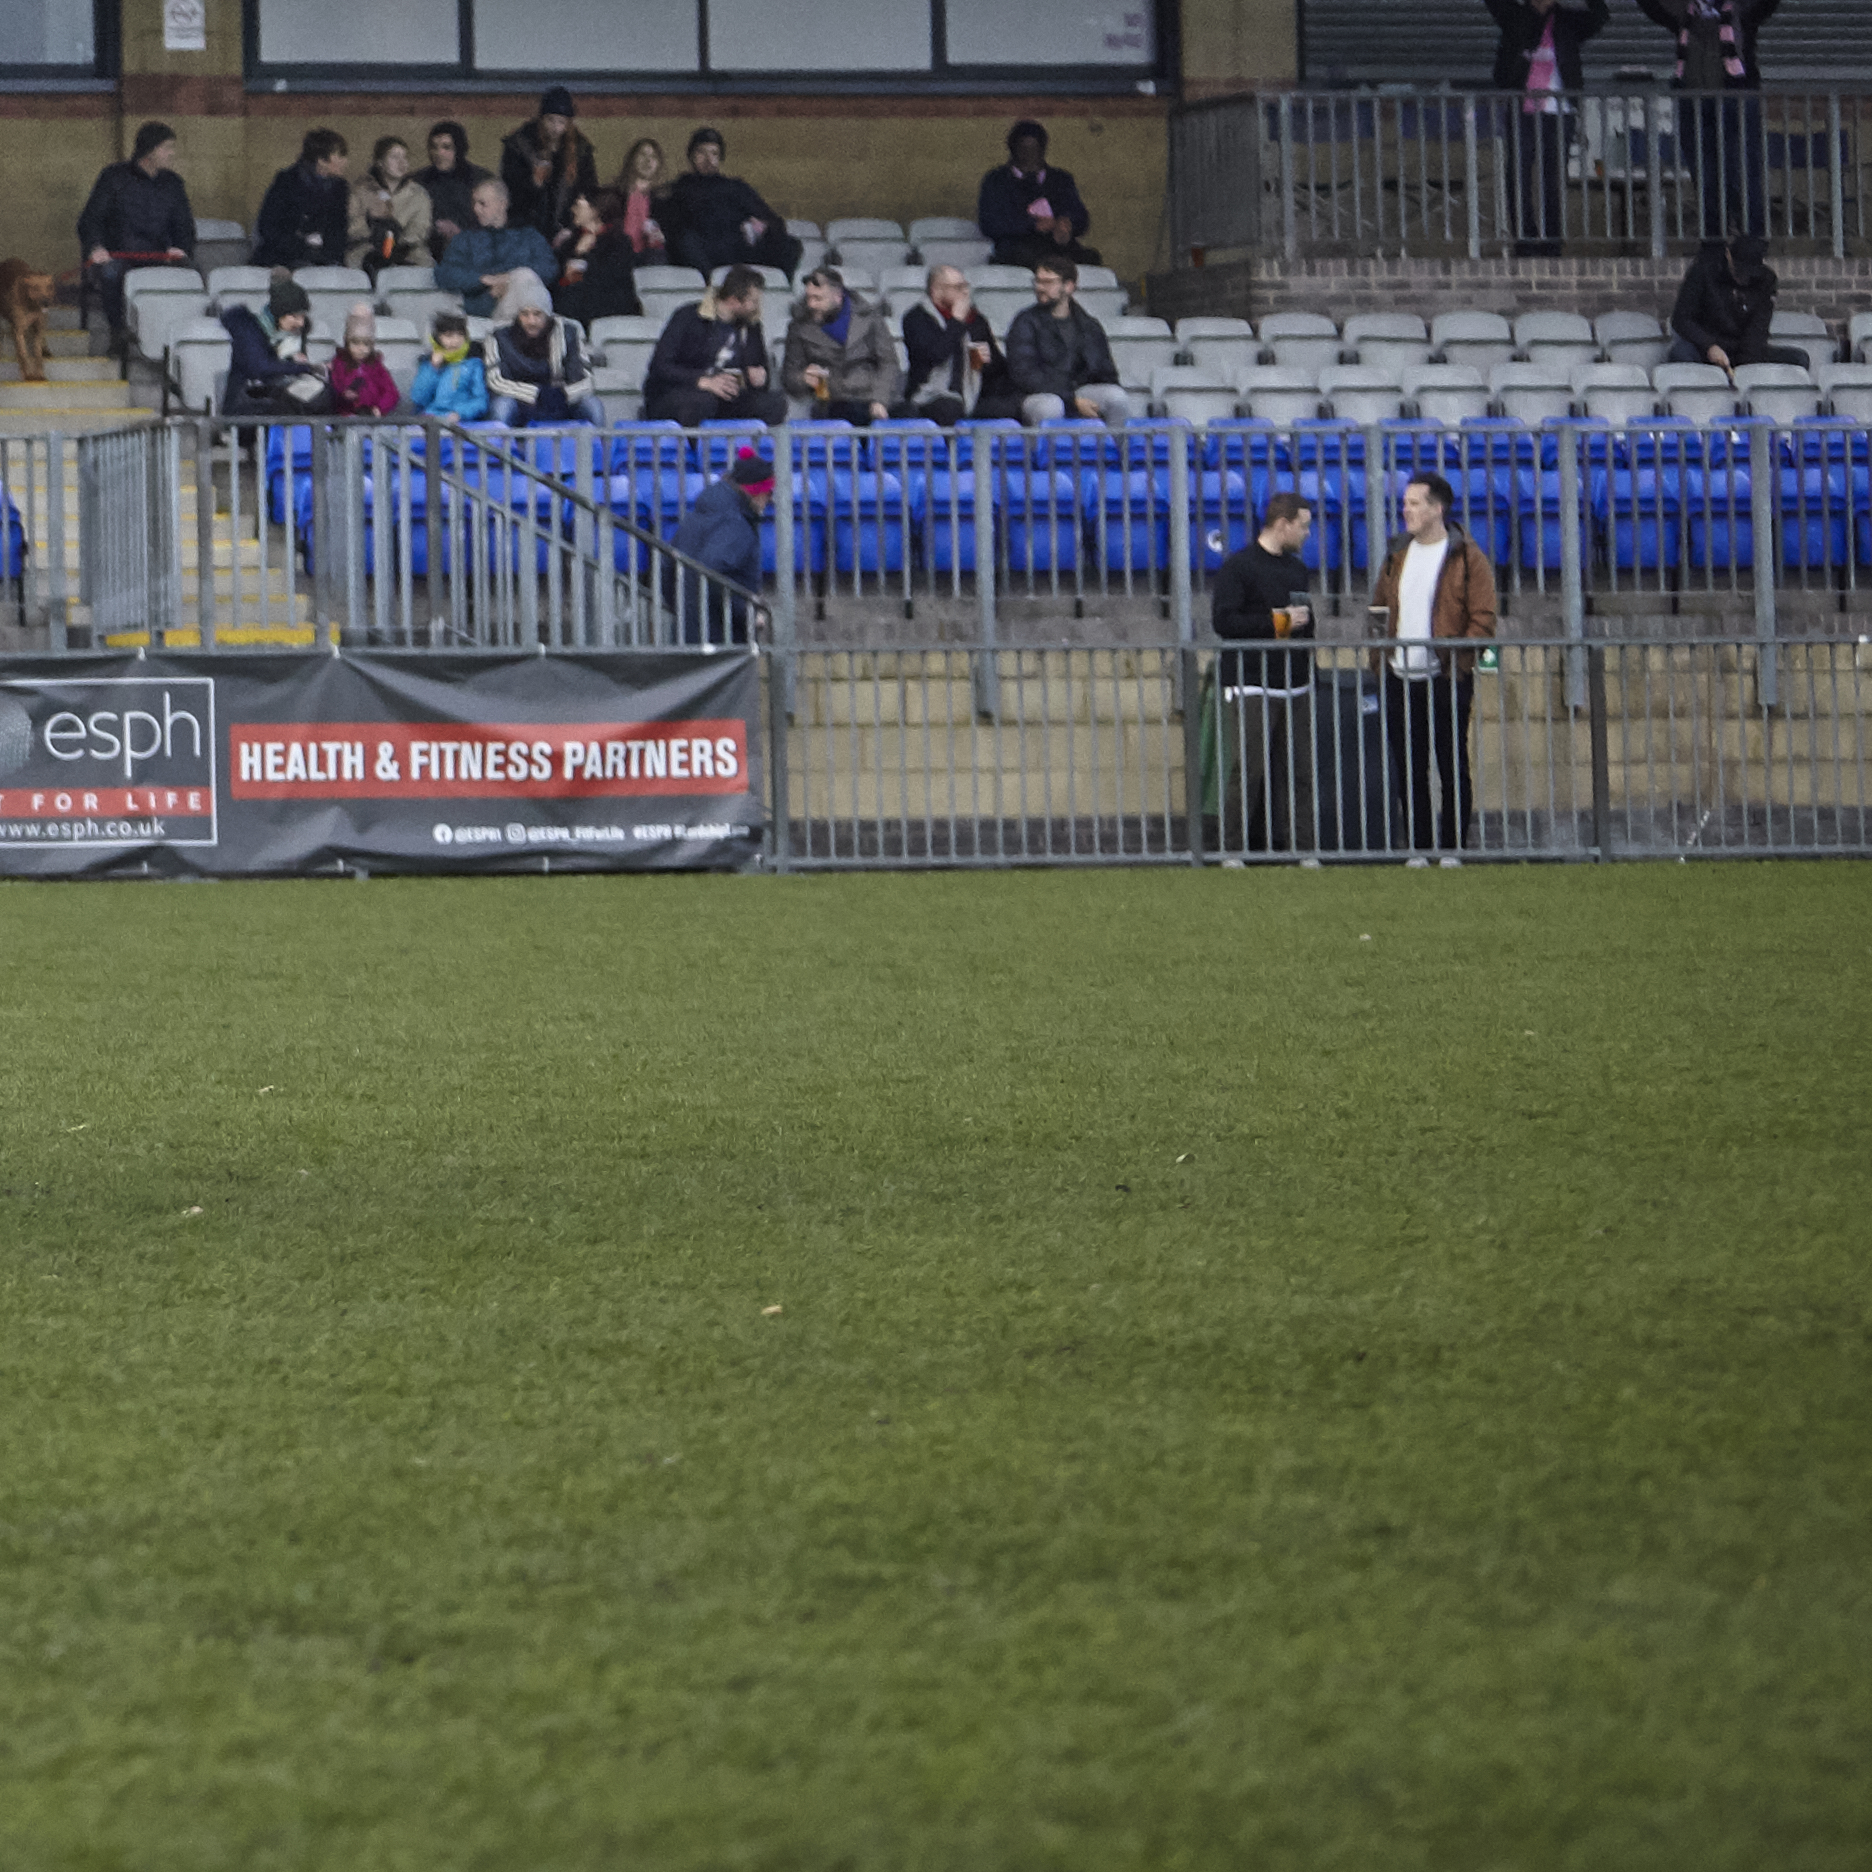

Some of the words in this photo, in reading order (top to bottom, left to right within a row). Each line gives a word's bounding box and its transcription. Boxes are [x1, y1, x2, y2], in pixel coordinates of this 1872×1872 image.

[43, 690, 201, 779] esph
[239, 741, 365, 781] HEALTH
[374, 741, 400, 781] &
[409, 739, 553, 781] FITNESS
[562, 737, 740, 780] PARTNERS
[32, 792, 99, 811] FOR
[126, 791, 202, 811] LIFE
